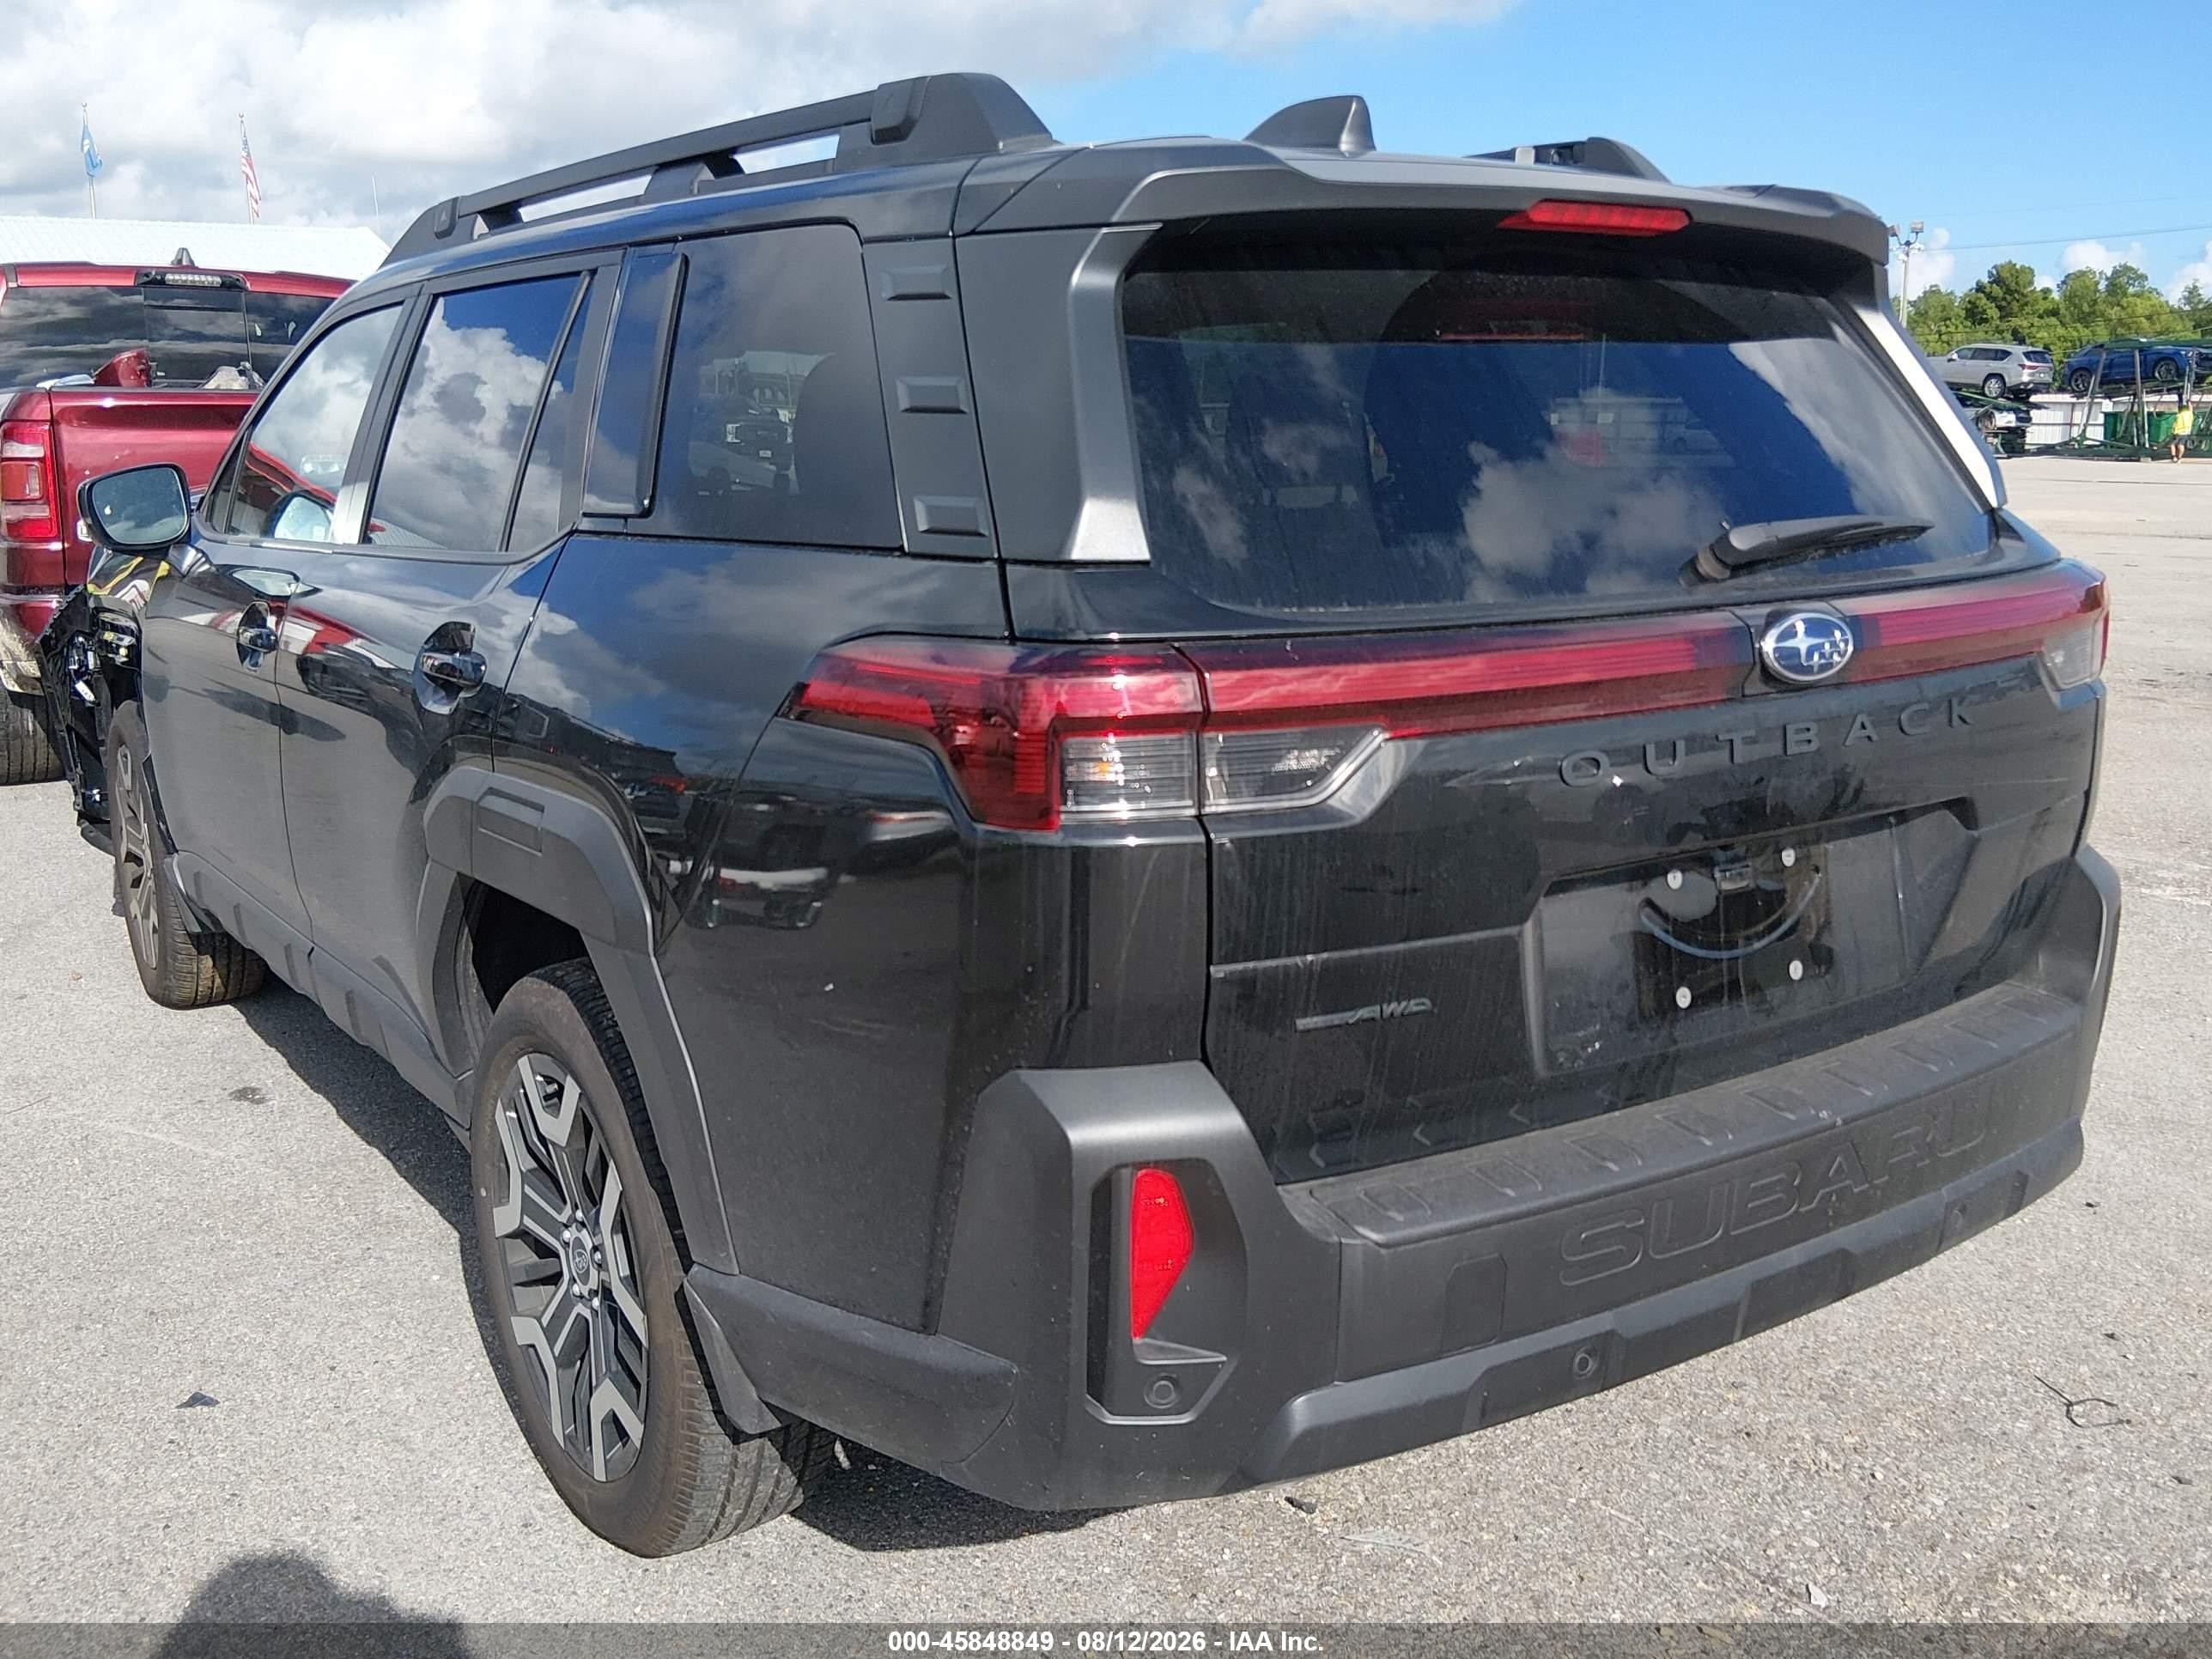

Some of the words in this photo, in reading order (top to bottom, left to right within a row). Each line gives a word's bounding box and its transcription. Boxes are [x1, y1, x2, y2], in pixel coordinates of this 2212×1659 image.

[1559, 696, 1972, 788] OUTBACK
[1346, 997, 1433, 1025] AWD
[1559, 1087, 1990, 1286] SUBARU
